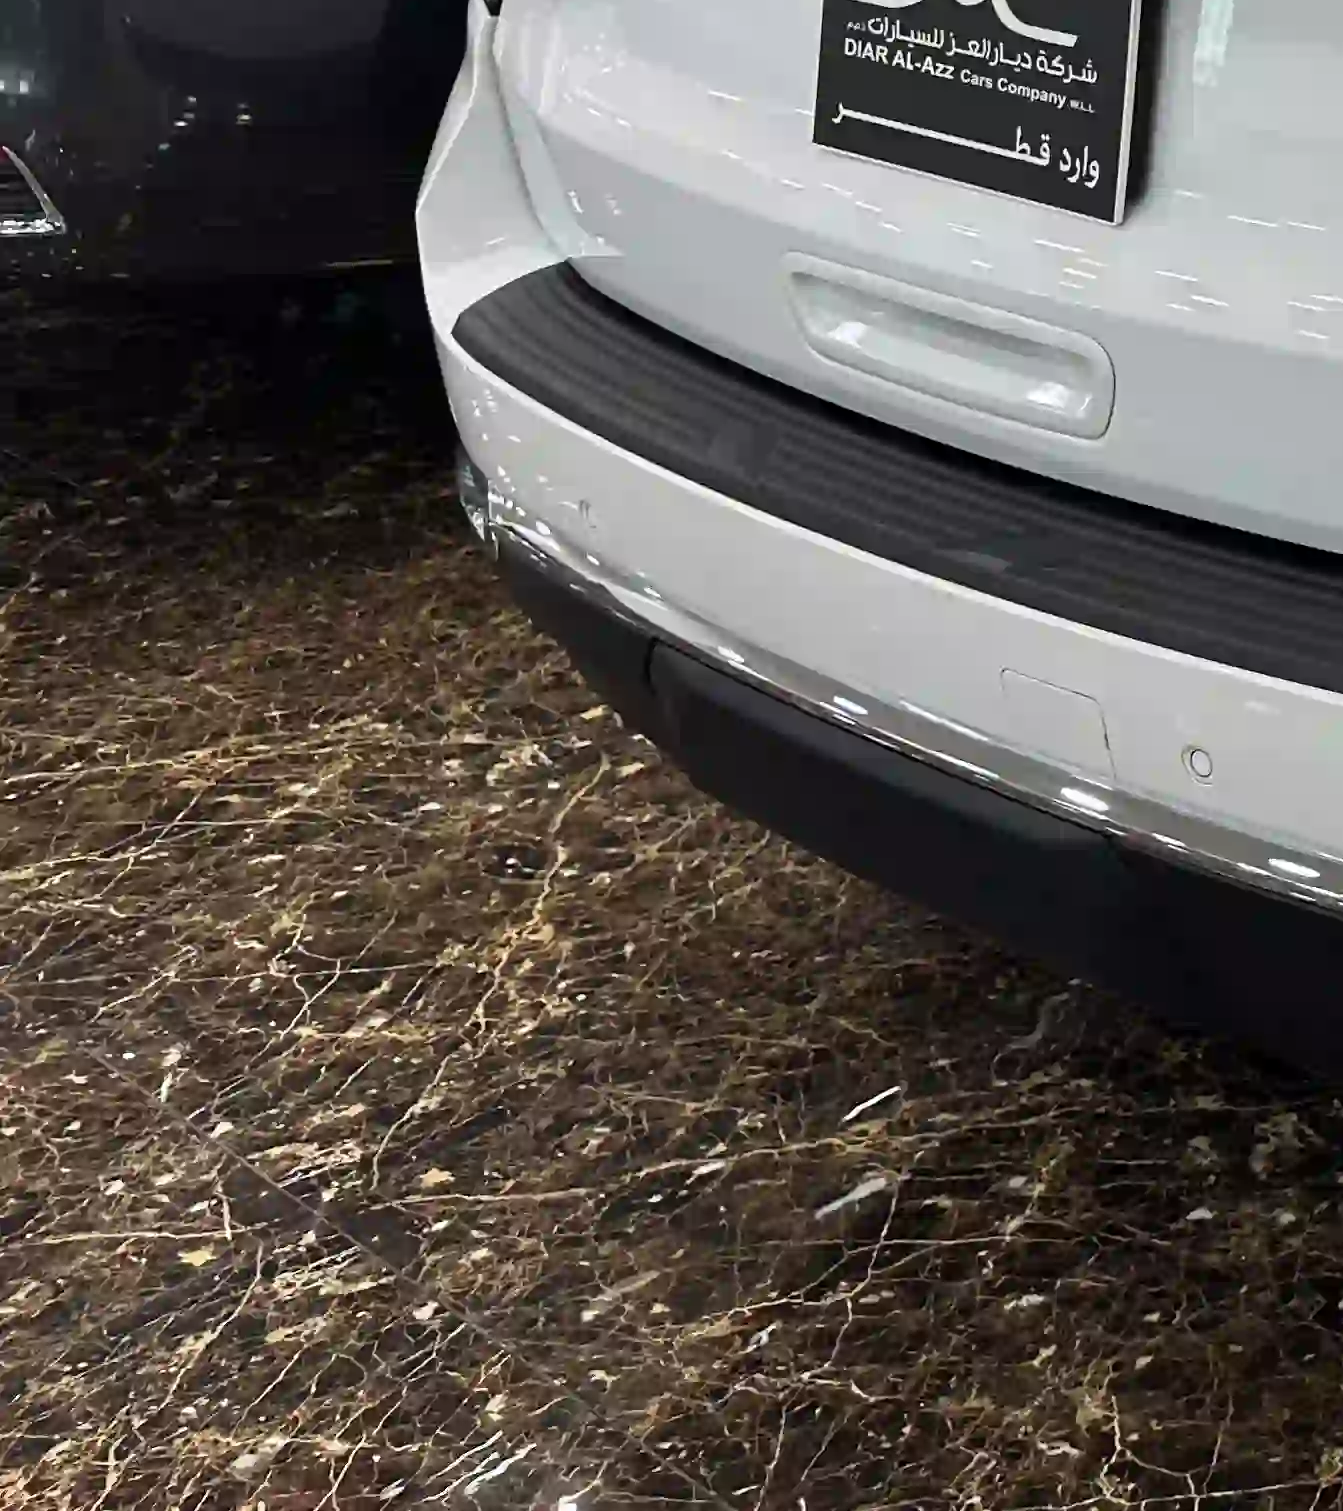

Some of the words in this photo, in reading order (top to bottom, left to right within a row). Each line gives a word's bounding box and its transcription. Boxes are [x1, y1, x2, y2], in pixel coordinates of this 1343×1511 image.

[867, 16, 945, 49] للسيارات
[844, 37, 889, 65] DIAR
[960, 69, 993, 89] Cars
[996, 77, 1067, 110] Company
[1036, 49, 1099, 84] شركة
[1058, 145, 1101, 189] وارد
